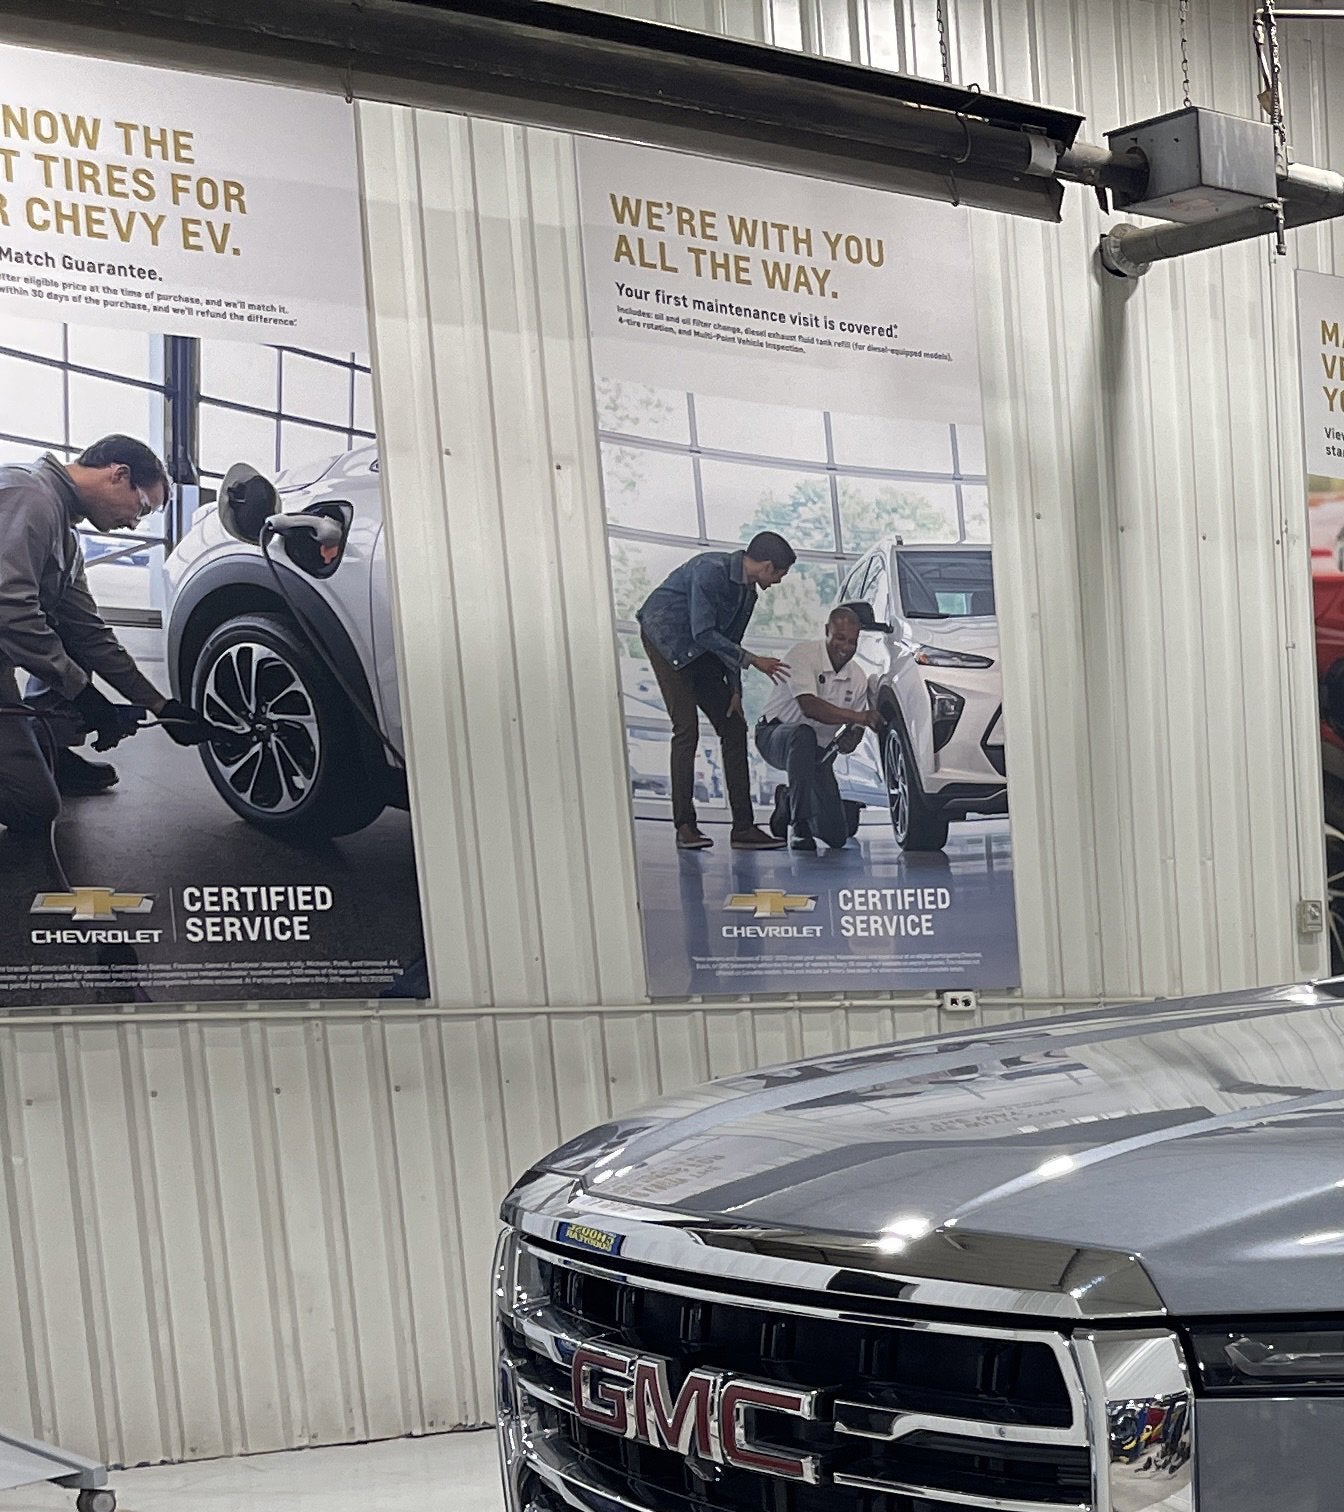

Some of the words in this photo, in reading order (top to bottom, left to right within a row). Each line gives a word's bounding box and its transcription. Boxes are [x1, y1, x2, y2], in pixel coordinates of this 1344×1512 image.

[2, 104, 101, 151] NOW
[115, 121, 195, 164] THE
[33, 153, 156, 202] TIRES
[171, 173, 247, 214] FOR
[26, 197, 167, 247] CHEVY
[181, 219, 241, 256] EV.
[728, 214, 813, 258] WITH
[821, 230, 885, 268] YOU
[0, 246, 56, 269] Match
[62, 255, 163, 281] Guarantee.
[614, 235, 678, 274] ALL
[687, 246, 752, 286] THE
[761, 259, 840, 299] WAY.
[24, 275, 59, 288] eligible
[62, 281, 87, 292] price
[90, 284, 100, 293] at
[102, 285, 118, 296] the
[121, 288, 141, 298] time
[145, 290, 154, 300] of
[206, 298, 222, 307] and
[248, 302, 276, 313] match
[31, 288, 44, 299] 30
[47, 291, 69, 304] days
[72, 294, 81, 304] of
[85, 296, 100, 306] the
[153, 305, 170, 314] and
[196, 309, 227, 320] refund
[230, 312, 244, 321] the
[615, 281, 650, 303] Your
[655, 289, 689, 309] first
[693, 299, 787, 325] maintenance
[789, 311, 820, 329] visit
[824, 315, 835, 331] is
[183, 886, 333, 912] CERTIFIED
[839, 888, 950, 911] CERTIFIED
[31, 929, 163, 945] CHEVROLET
[185, 916, 311, 942] SERVICE
[722, 925, 823, 938] CHEVROLET
[841, 914, 935, 937] SERVICE
[571, 1344, 822, 1485] GMC
